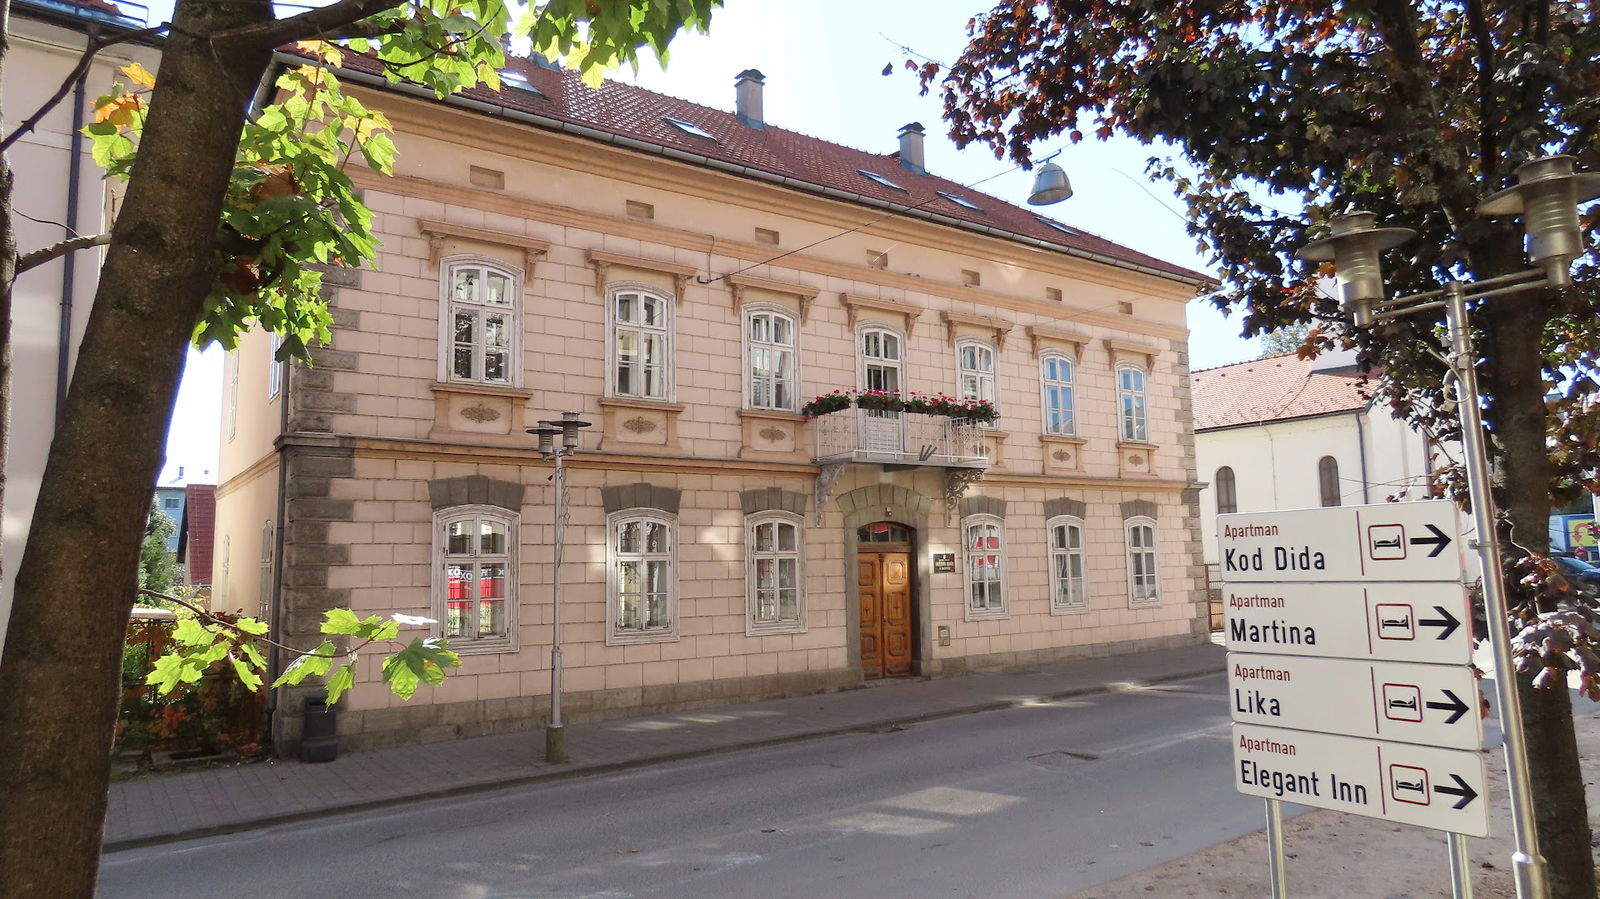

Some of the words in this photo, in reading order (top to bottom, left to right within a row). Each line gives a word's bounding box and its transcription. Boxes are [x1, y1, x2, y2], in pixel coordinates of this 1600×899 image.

[1225, 524, 1278, 540] Apartman
[1225, 548, 1262, 571] Kod
[1274, 546, 1325, 570] Dida
[1230, 594, 1284, 610] Apartman
[1231, 618, 1315, 645] Martina
[1235, 664, 1290, 681] Apartman
[1236, 689, 1280, 716] Lika
[1240, 735, 1295, 755] Apartman
[1241, 760, 1320, 796] Elegant
[1331, 774, 1367, 805] Inn
